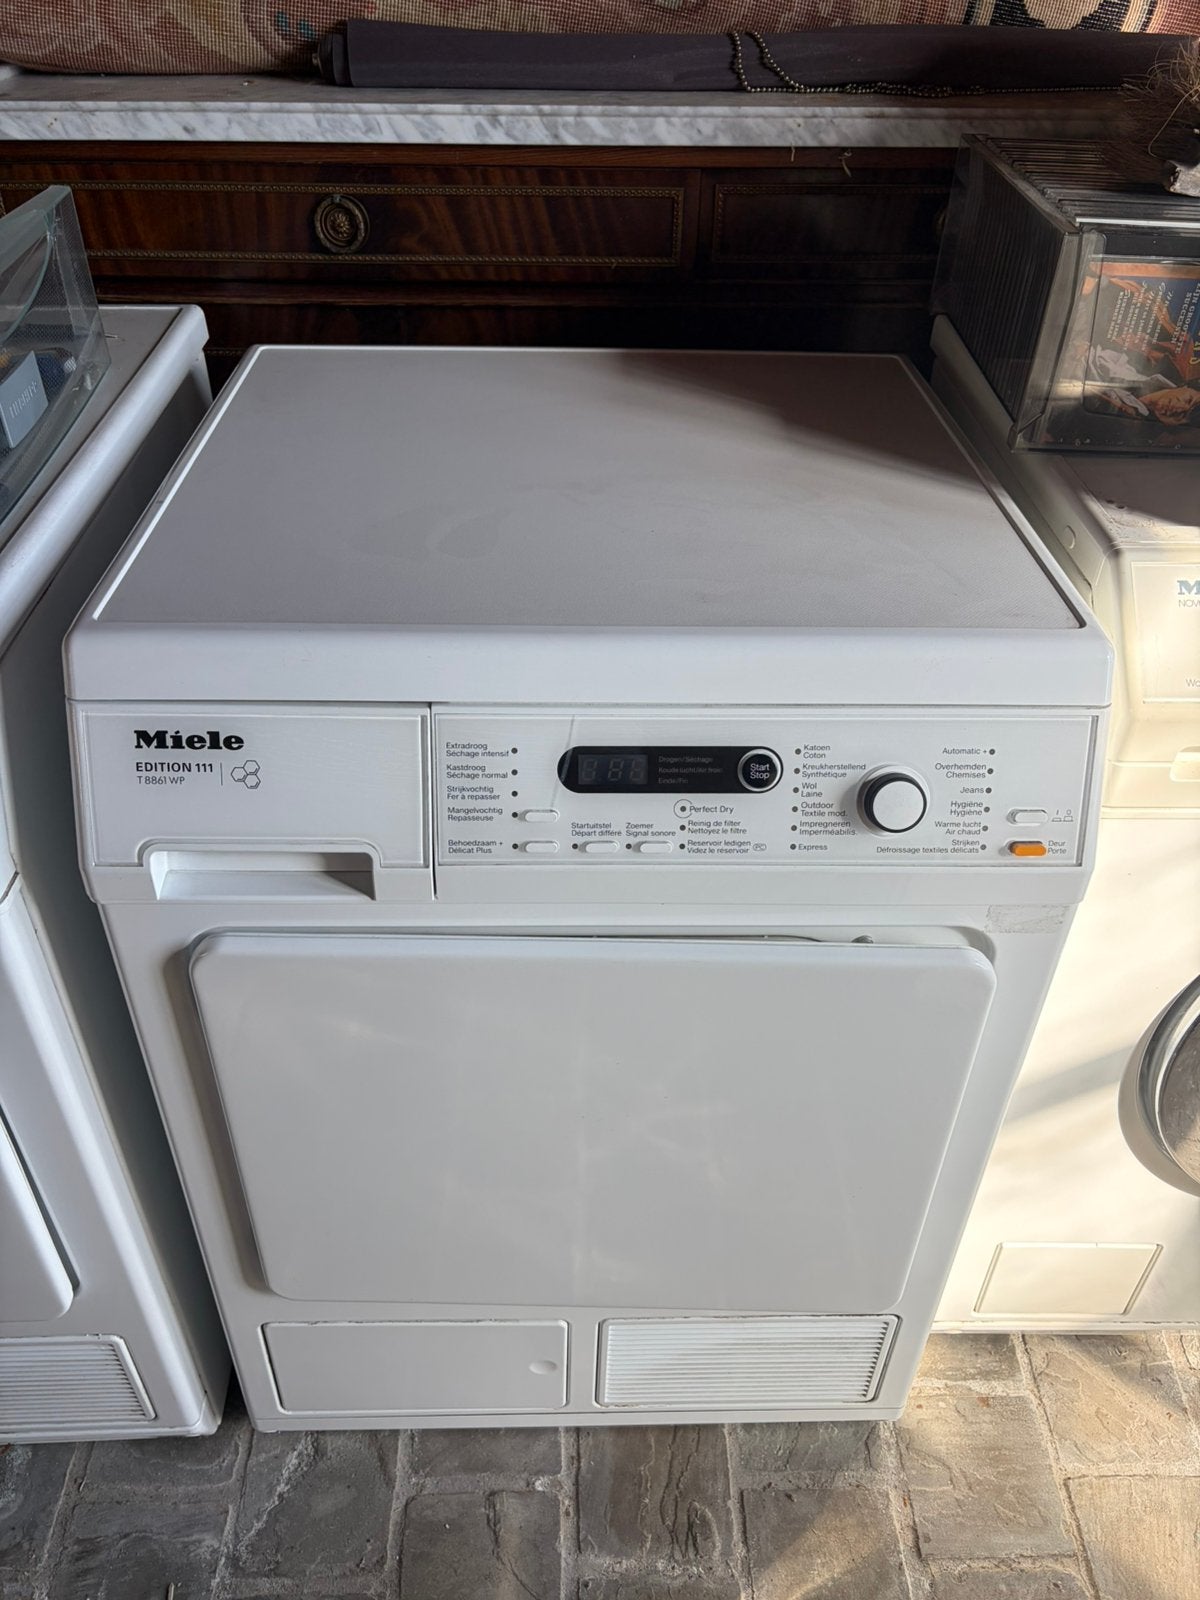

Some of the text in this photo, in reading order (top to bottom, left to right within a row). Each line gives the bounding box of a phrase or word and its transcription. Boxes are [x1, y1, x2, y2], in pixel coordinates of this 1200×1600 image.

[134, 730, 244, 750] Miele
[446, 742, 488, 751] Extradroog
[446, 750, 479, 758] Séchage
[803, 751, 826, 759] Coton
[942, 747, 981, 755] Automatic
[136, 762, 213, 773] EDITION 111
[446, 764, 486, 772] Kastdroog
[750, 763, 770, 771] Start
[935, 763, 986, 771] Overhemden
[446, 772, 480, 780] Séchage
[750, 771, 770, 780] Stop
[802, 770, 847, 779] Synthétique
[945, 771, 986, 779] Chemises
[168, 777, 185, 785] WP
[447, 785, 494, 794] Strijkvochtig
[802, 782, 818, 790] Wol
[960, 786, 985, 794] Jeans
[801, 790, 823, 798] Laine
[447, 807, 503, 815] Mangelvochtig
[689, 805, 735, 815] Perfect Dry
[447, 814, 494, 822] Repasseuse
[687, 820, 711, 828] Reinig
[571, 829, 597, 837] Départ
[625, 829, 649, 838] Signal
[687, 827, 720, 836] Nettoyez
[945, 828, 981, 836] Air chaud
[448, 839, 497, 847] Behoedzaam
[724, 840, 751, 848] ledigen
[951, 839, 980, 847] Strijken
[798, 844, 828, 852] Express
[922, 846, 948, 854] textiles
[950, 846, 979, 854] délicats
[1048, 847, 1067, 855] Porte
